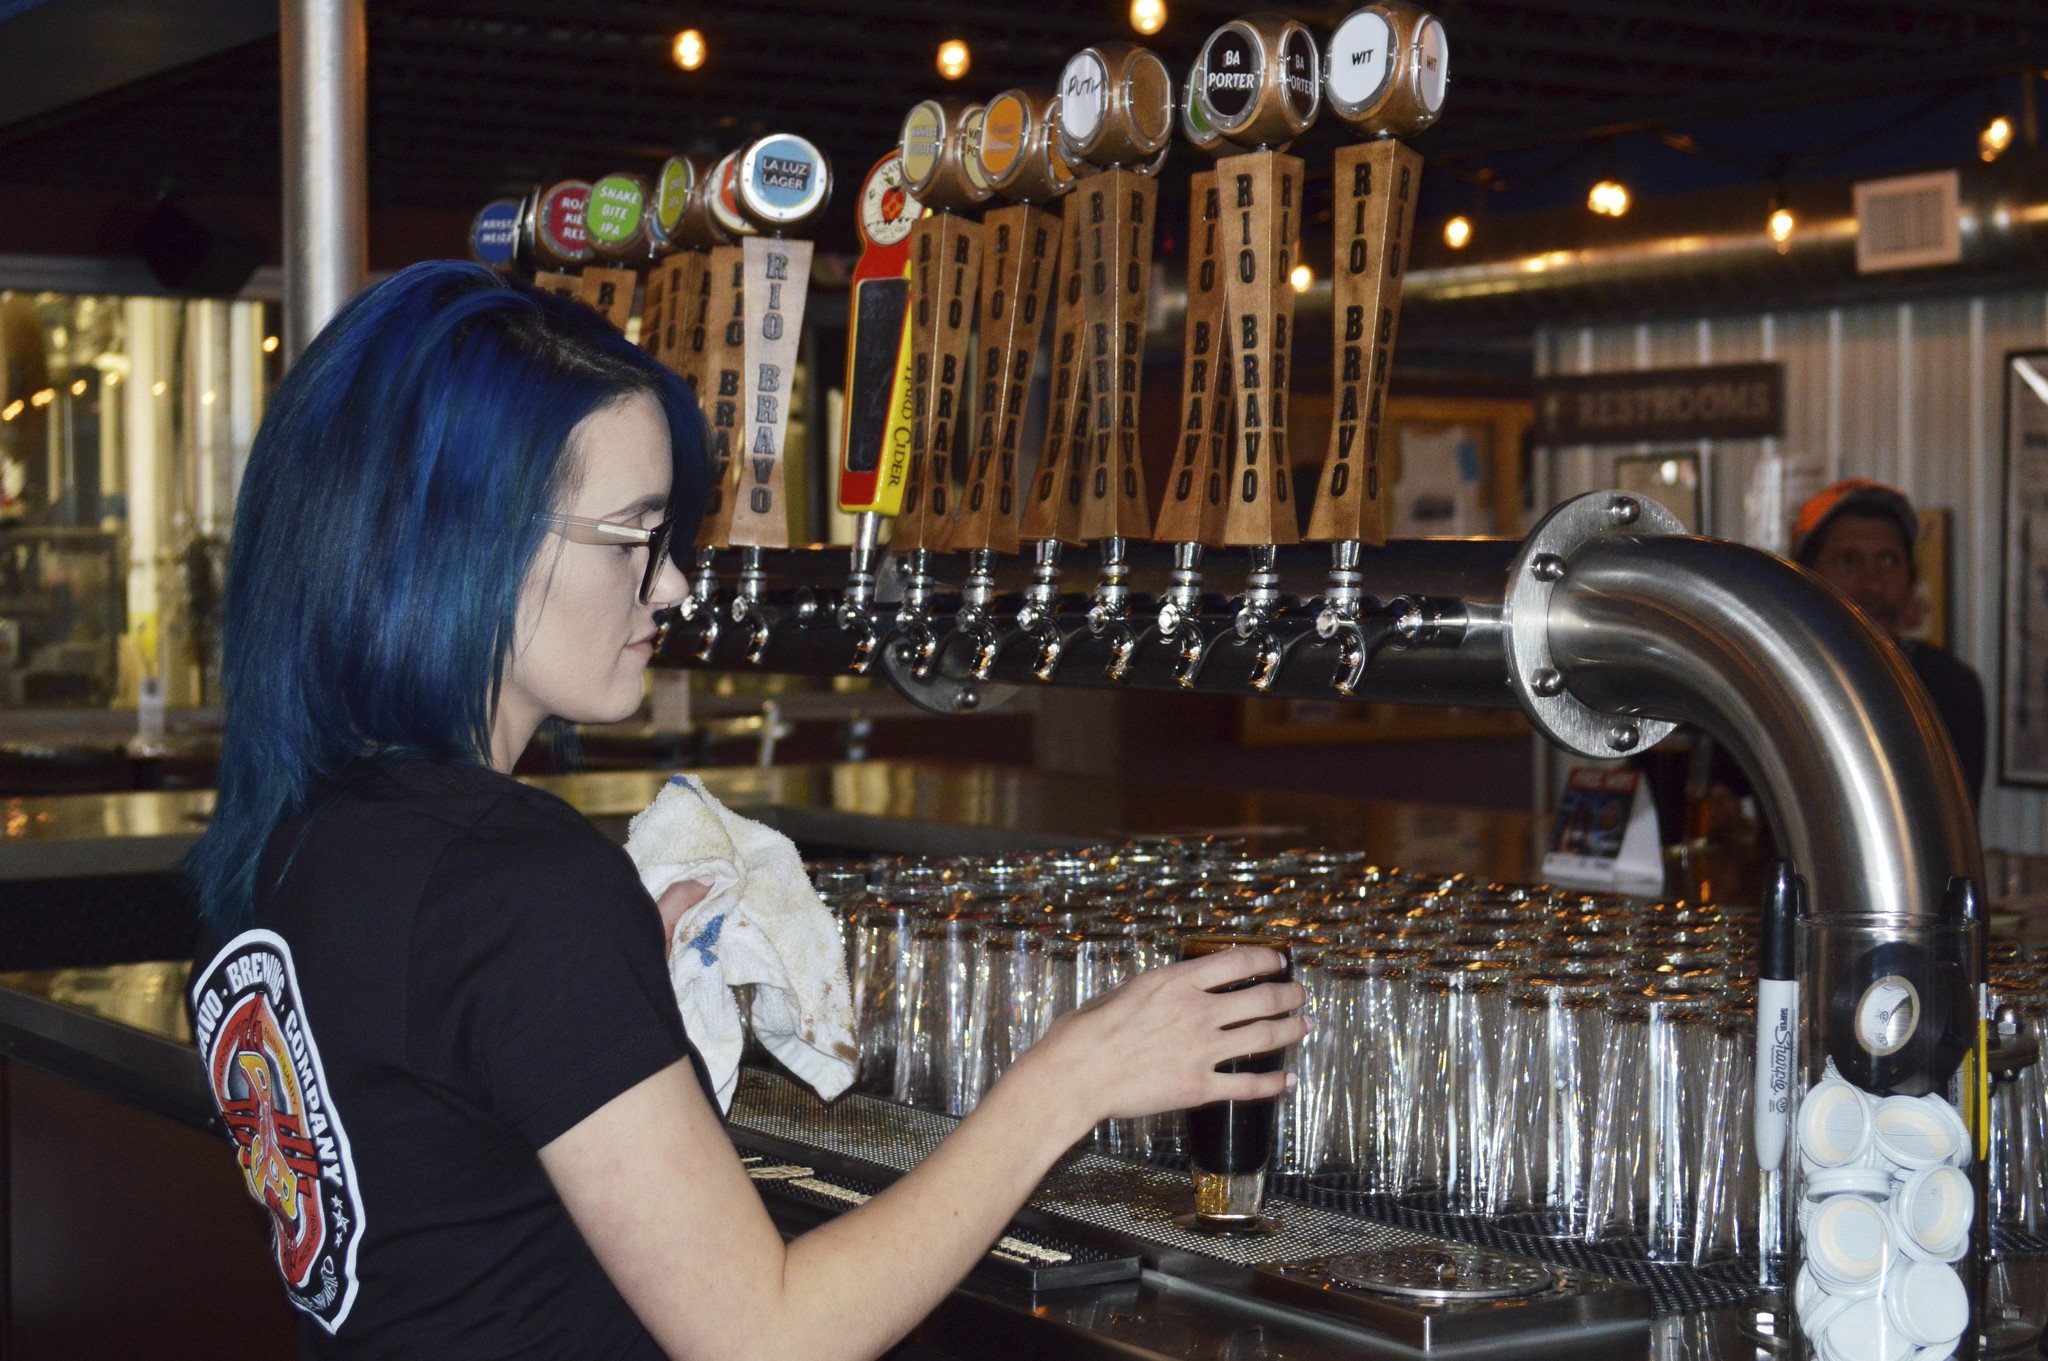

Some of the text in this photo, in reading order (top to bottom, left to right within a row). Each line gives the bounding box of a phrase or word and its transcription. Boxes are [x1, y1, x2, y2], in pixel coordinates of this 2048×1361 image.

[1208, 72, 1255, 88] PORTER
[1225, 50, 1240, 66] BA
[1295, 54, 1305, 70] BA
[1351, 48, 1374, 66] WIT
[600, 186, 641, 205] SNAKE
[601, 221, 620, 236] IPA
[602, 203, 629, 220] BITE
[762, 156, 809, 175] LA LUZ
[762, 173, 803, 190] LAGER
[750, 252, 788, 514] RIO BRAVO
[933, 233, 970, 516] RIO BRAVO
[970, 223, 1011, 512] RIO BRAVO
[1000, 227, 1048, 516] RIO BRAVO
[1091, 190, 1111, 499] RIO BRAVO
[1121, 190, 1144, 499] RIO BRAVO
[1176, 187, 1219, 502] RIO BRAVO
[1236, 173, 1262, 503] RIO BRAVO
[1272, 173, 1293, 503] RIO BRAVO
[1330, 162, 1372, 497] RIO BRAVO
[1368, 165, 1411, 501] RIO BRAVO
[888, 426, 912, 487] CIDER
[906, 353, 928, 515] BRAVO
[1039, 332, 1076, 501] BRAVO
[226, 951, 285, 1008] BREWING
[285, 1009, 343, 1187] COMPANY
[1773, 1025, 1791, 1093] Sharpie
[1780, 1007, 1788, 1032] SUPER
